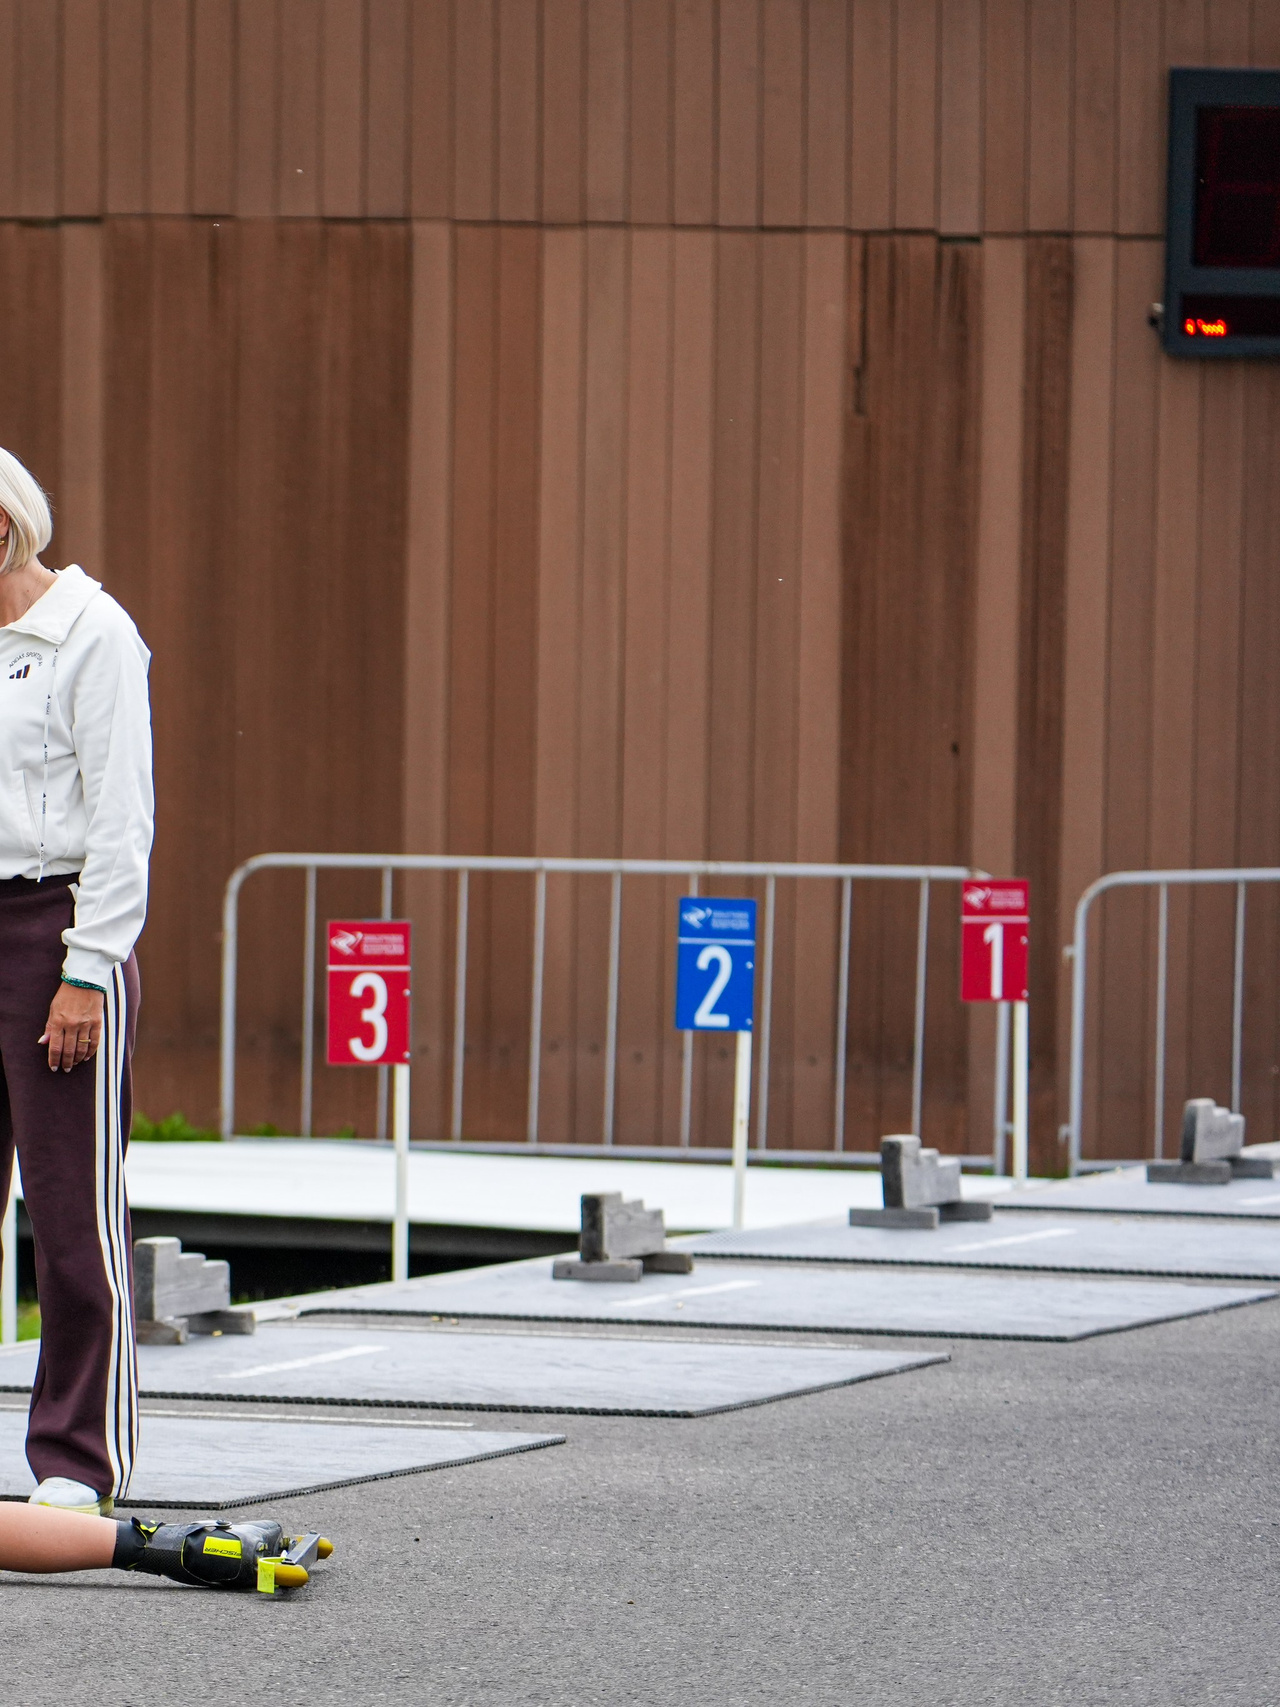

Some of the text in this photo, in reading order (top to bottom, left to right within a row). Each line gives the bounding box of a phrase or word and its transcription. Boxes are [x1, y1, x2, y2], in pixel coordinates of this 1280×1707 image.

[694, 944, 732, 1028] 2
[983, 922, 1003, 999] 1
[349, 972, 388, 1061] 3
[205, 1547, 242, 1556] FISCHER
